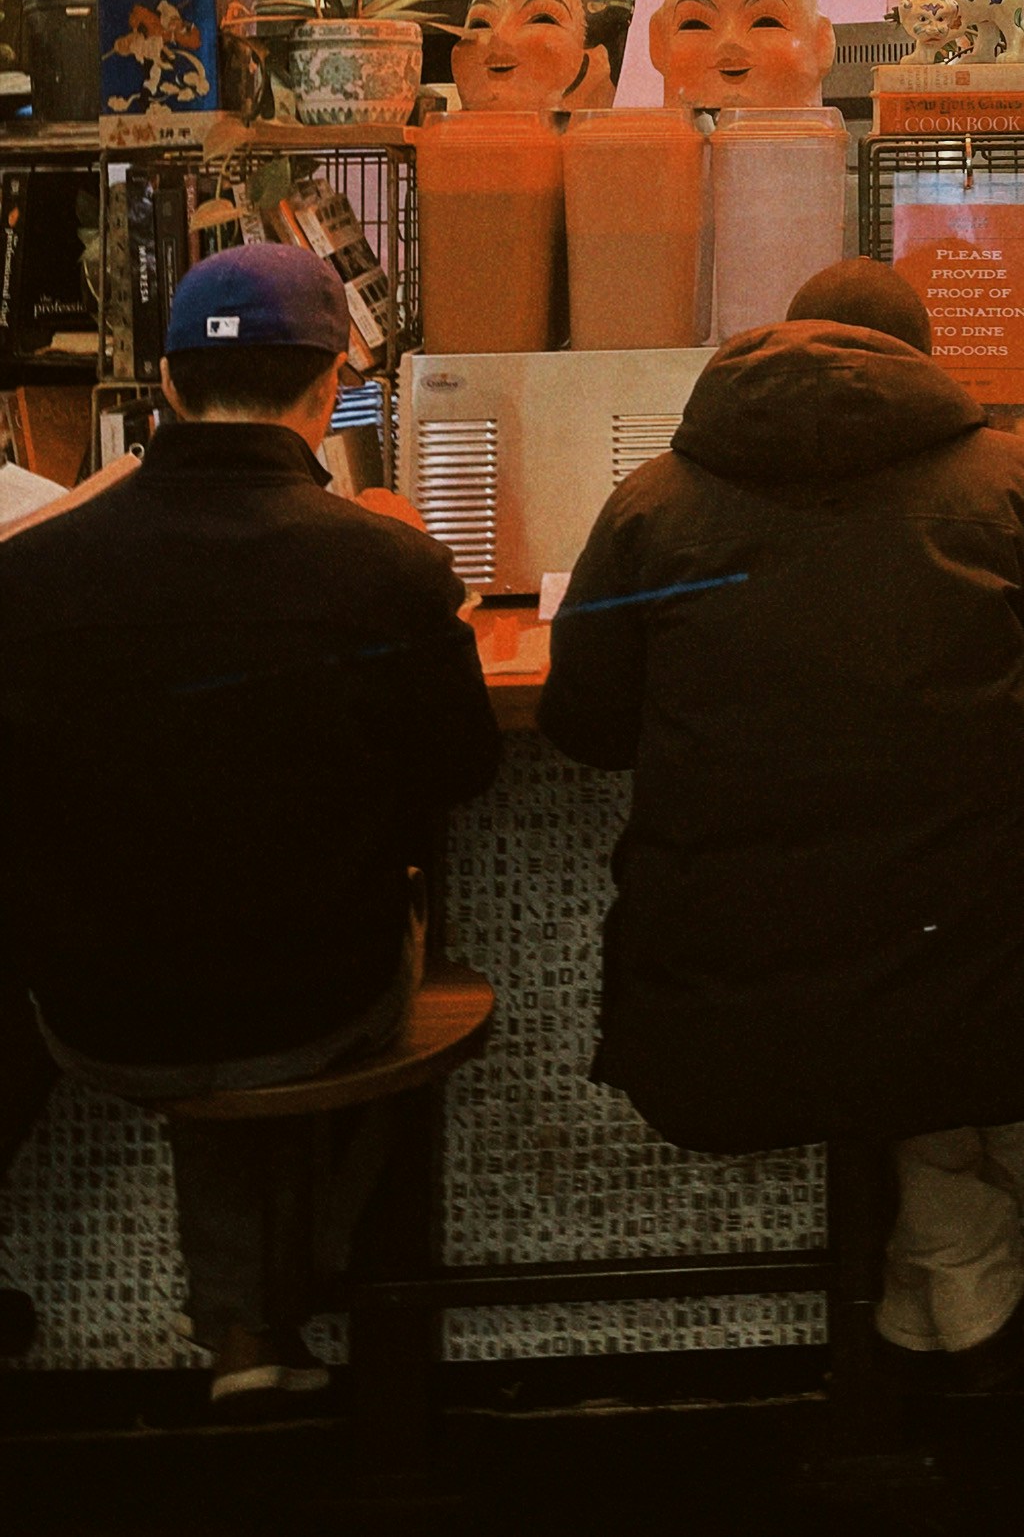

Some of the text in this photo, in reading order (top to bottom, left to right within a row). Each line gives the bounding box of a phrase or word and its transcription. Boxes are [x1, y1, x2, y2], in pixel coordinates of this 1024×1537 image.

[935, 248, 1003, 261] PLEASE
[931, 268, 1007, 280] PROVIDE
[927, 287, 1012, 299] PROOF OF
[934, 325, 1004, 337] TO DINE
[931, 344, 1009, 357] INDOORS
